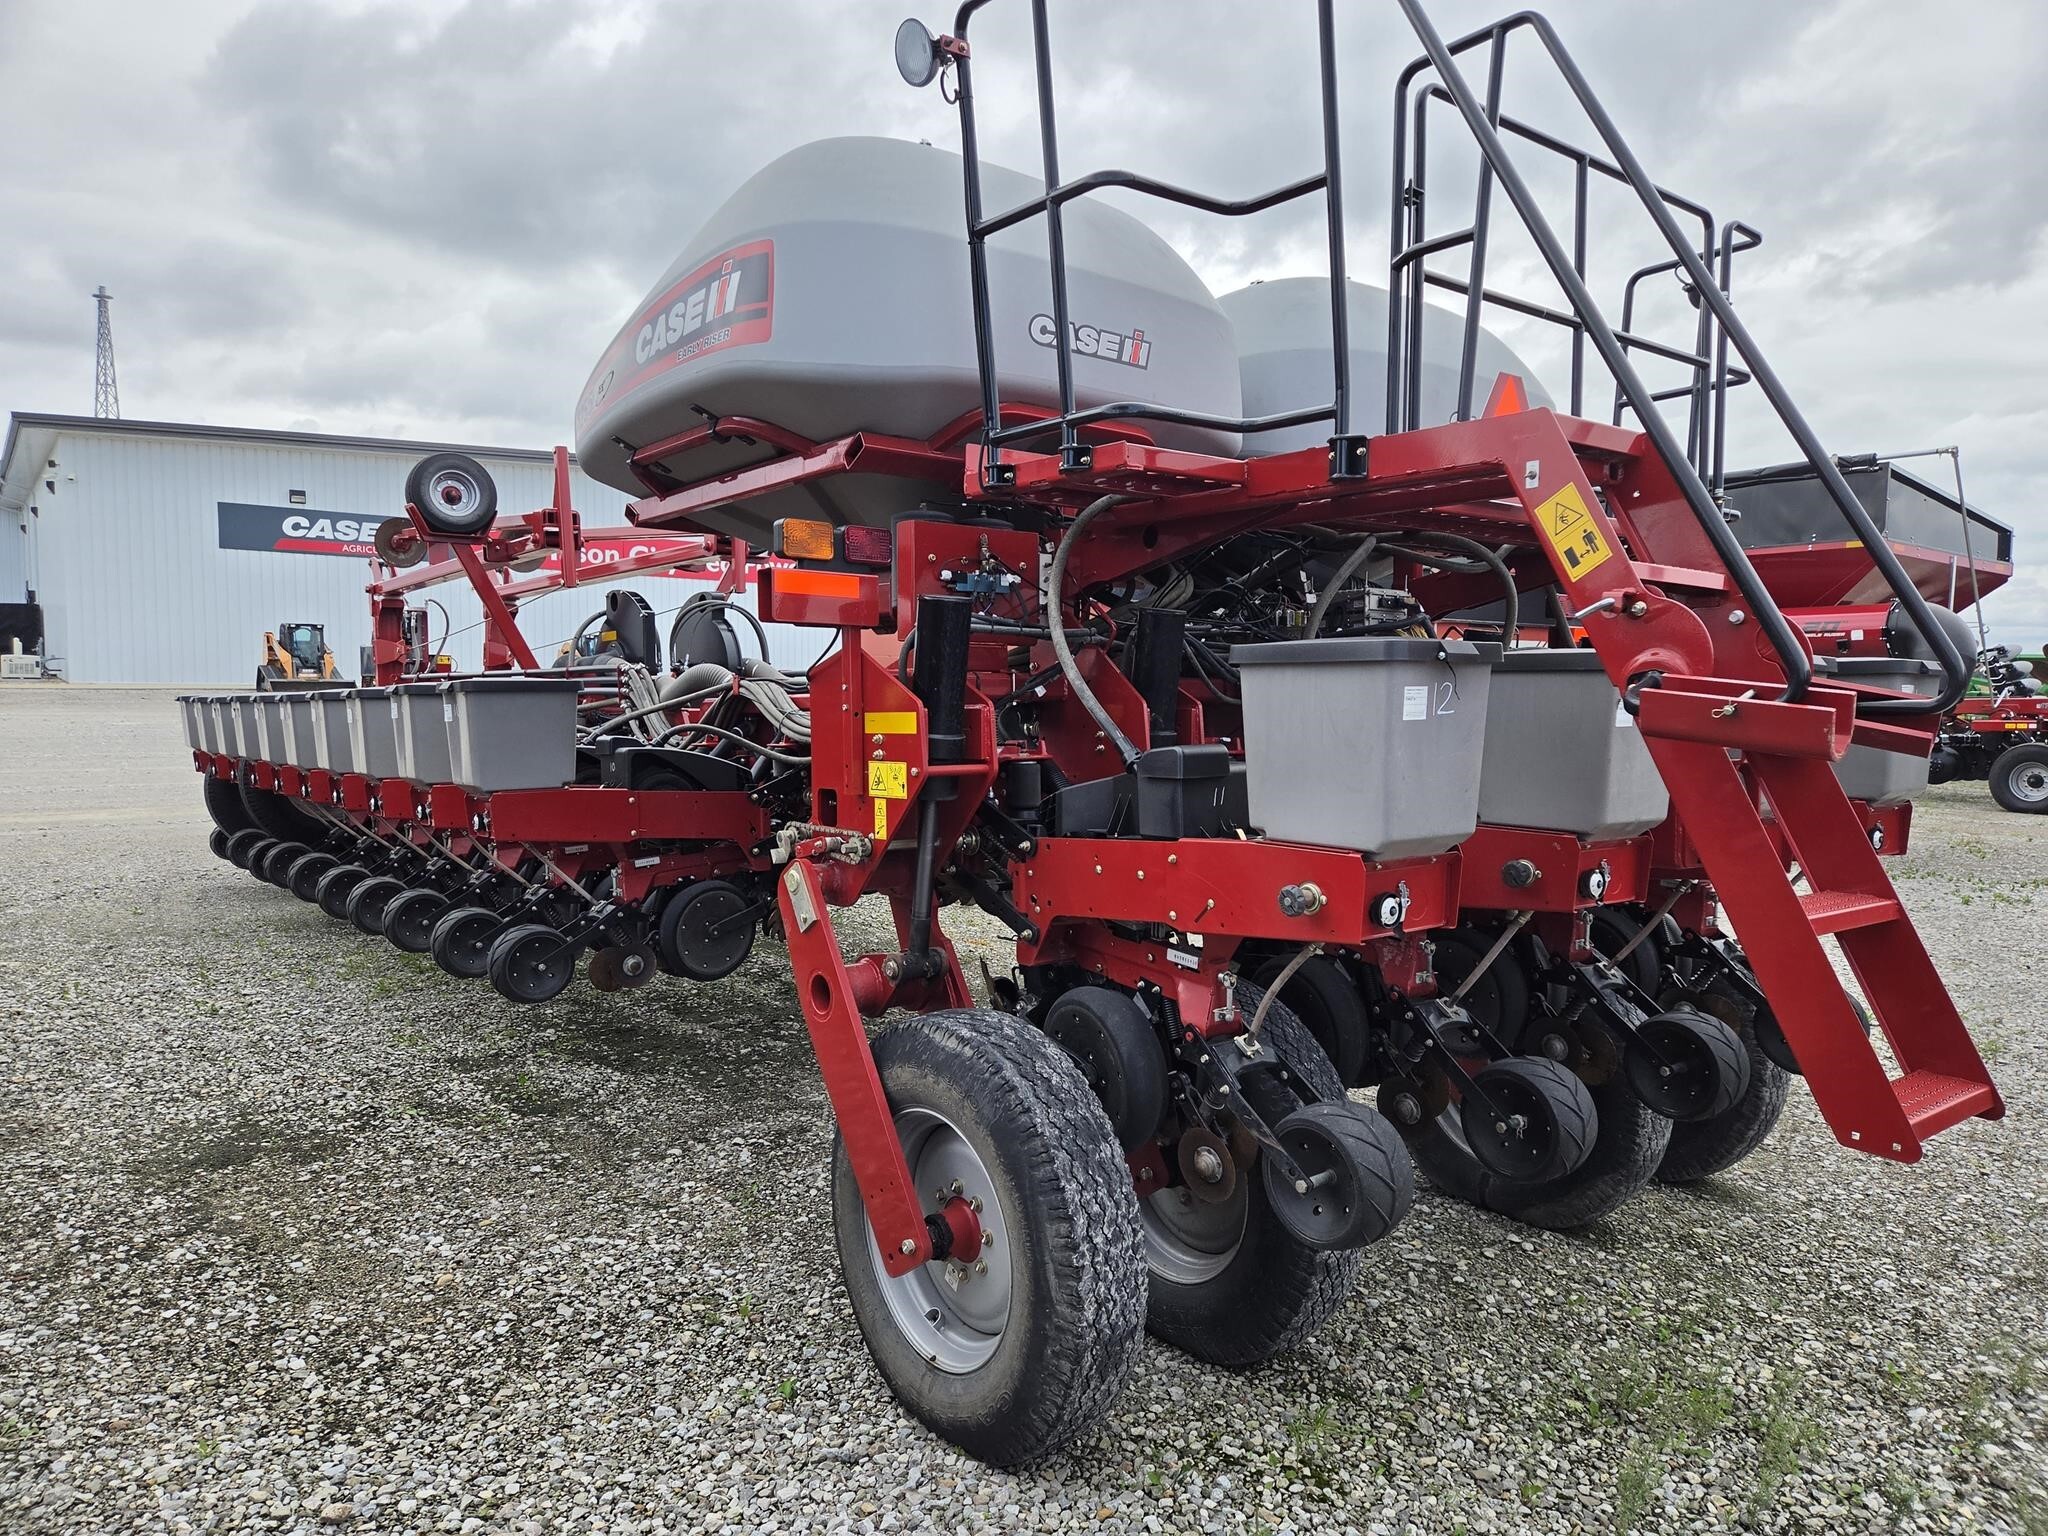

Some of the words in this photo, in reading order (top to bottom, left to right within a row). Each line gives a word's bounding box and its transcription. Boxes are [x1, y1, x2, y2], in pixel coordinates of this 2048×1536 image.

[636, 287, 707, 365] CASE
[677, 338, 704, 362] EARLY
[703, 327, 732, 349] RISER
[282, 516, 380, 542] CASE
[1432, 682, 1455, 717] 12
